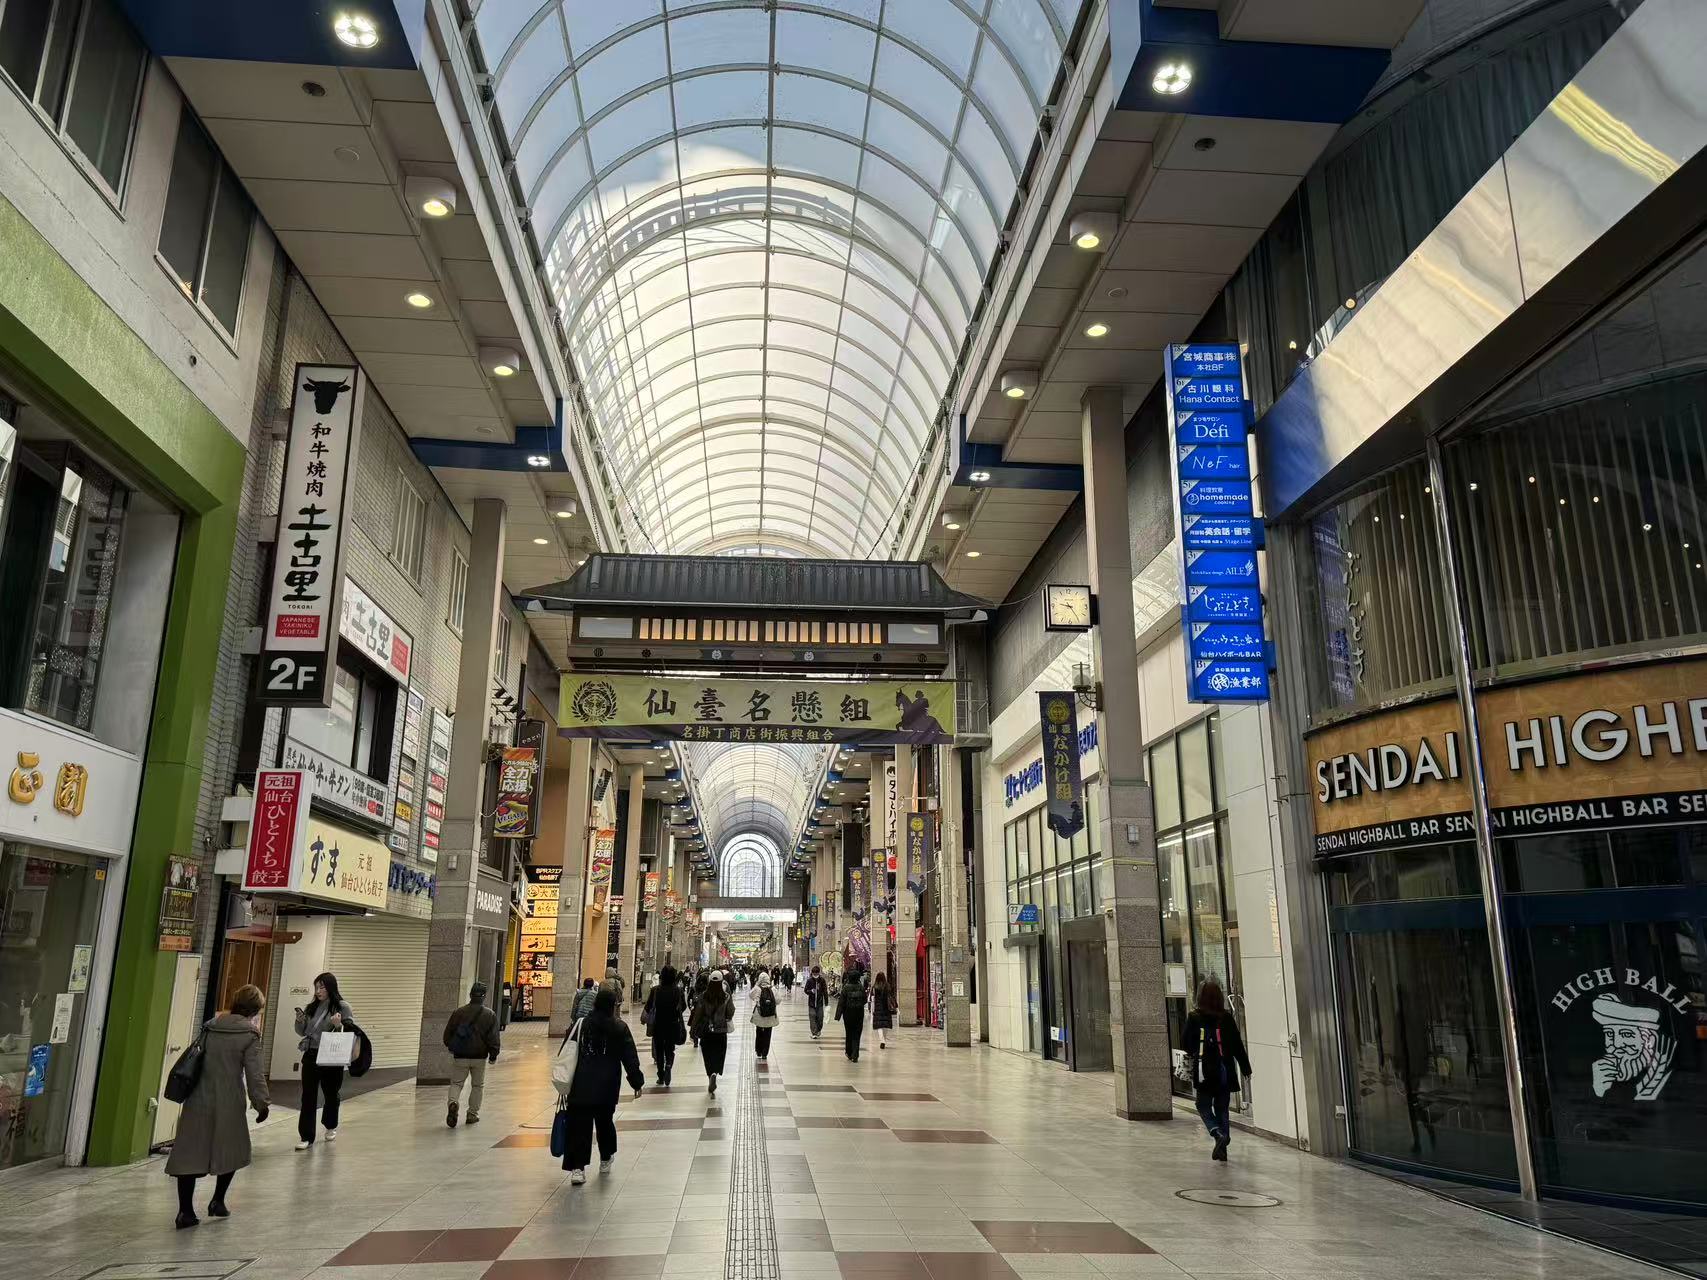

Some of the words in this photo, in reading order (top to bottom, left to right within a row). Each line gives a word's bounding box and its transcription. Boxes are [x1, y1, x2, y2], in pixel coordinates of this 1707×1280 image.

[1187, 384, 1235, 393] 古川眼科
[1204, 395, 1240, 403] Contact
[1194, 423, 1229, 438] Défi
[305, 422, 332, 498] 和牛焼肉
[1200, 493, 1249, 501] homemade
[283, 503, 332, 602] 土古里
[267, 657, 317, 690] 2F
[643, 688, 872, 723] 仙臺名懸組
[681, 725, 835, 741] 名掛丁商店街振興組合
[504, 766, 529, 779] 全力
[1316, 732, 1461, 804] SENDAI
[266, 775, 294, 787] 元祖
[502, 779, 528, 792] 応援
[264, 790, 294, 803] 仙台
[1317, 834, 1347, 852] SENDAI
[1349, 824, 1407, 845] HIGHBALL
[1410, 819, 1439, 836] BAR
[1445, 811, 1507, 833] SENAI
[1512, 802, 1614, 828] HIGHBALL
[1621, 798, 1669, 817] BAR
[1679, 795, 1707, 813] SE
[263, 805, 286, 868] ひとくち
[357, 853, 372, 873] 元祖
[252, 869, 285, 885] 餃子
[340, 872, 384, 898] 仙台ひとくち餃子
[476, 890, 503, 914] PARADISE
[1551, 967, 1616, 1013] HIGH
[1624, 968, 1692, 1015] BALL
